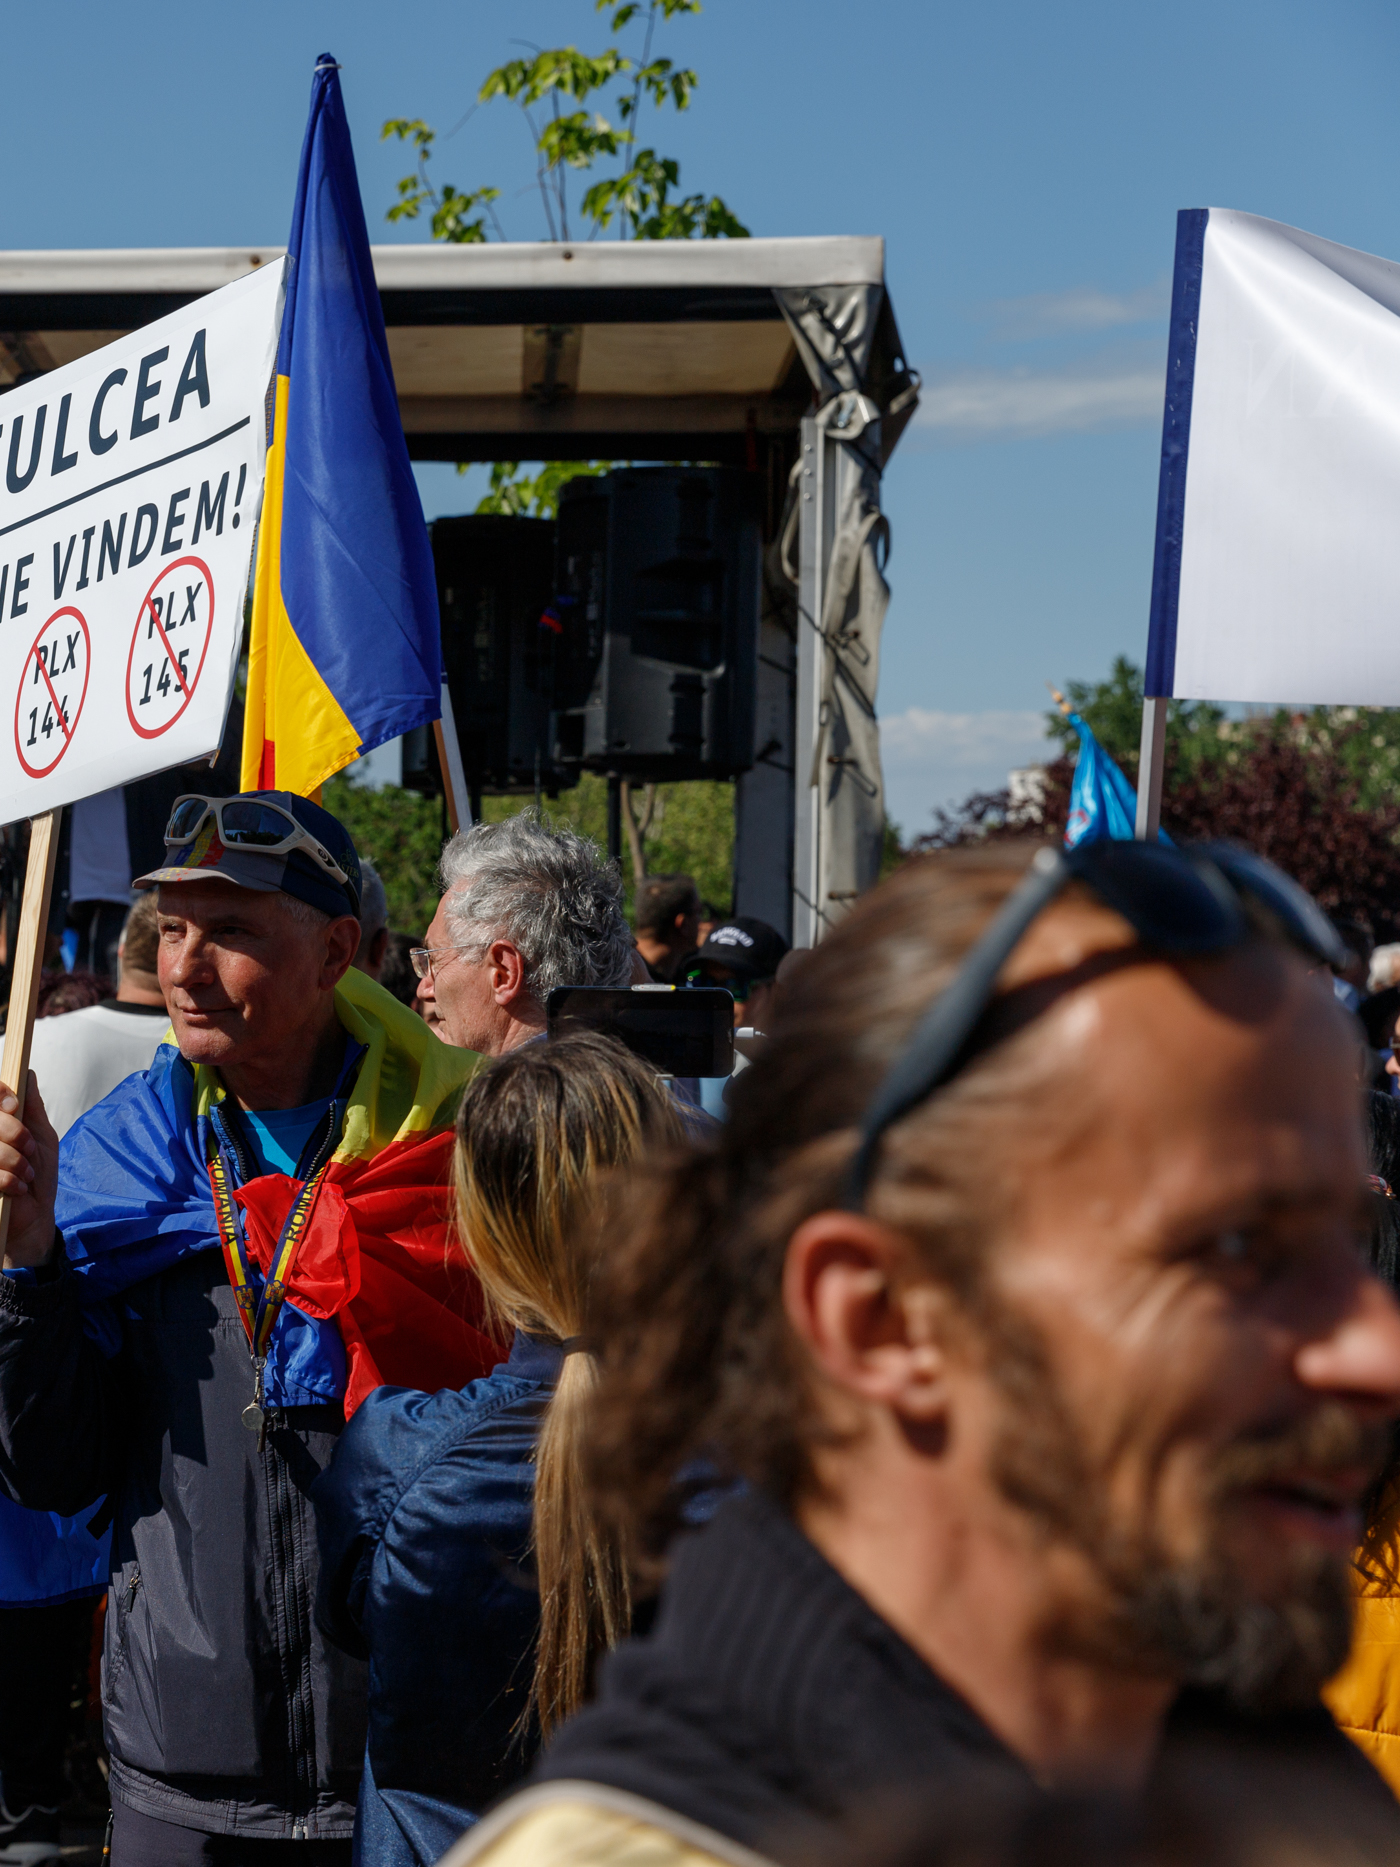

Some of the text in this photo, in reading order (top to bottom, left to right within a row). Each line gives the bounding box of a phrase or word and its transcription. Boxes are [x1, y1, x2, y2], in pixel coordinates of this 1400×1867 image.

[53, 463, 247, 600] VINDEM!
[148, 582, 203, 640] PLX
[34, 631, 80, 684] PLX
[139, 648, 190, 706] 145
[27, 695, 70, 747] 144
